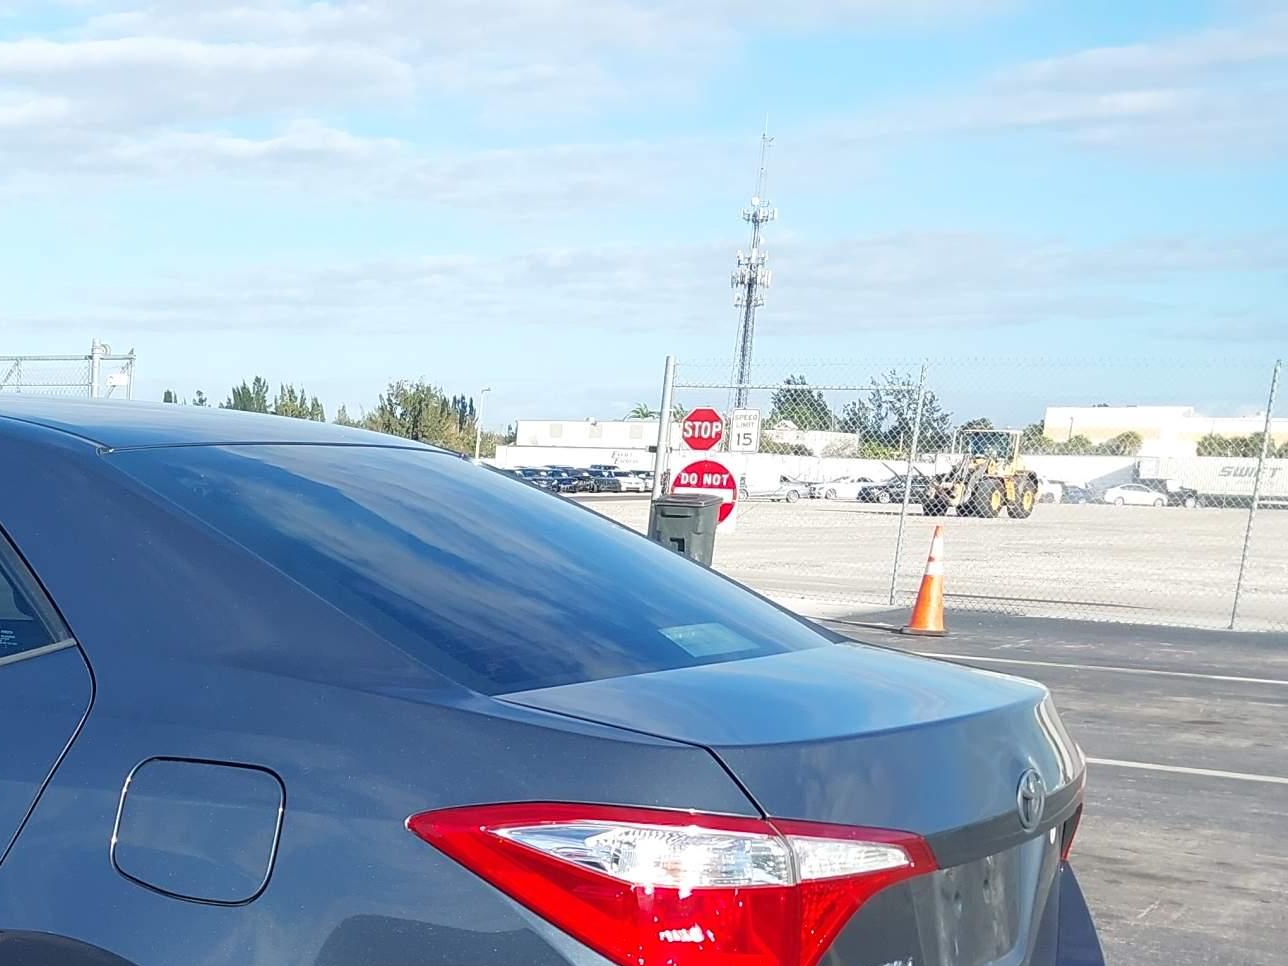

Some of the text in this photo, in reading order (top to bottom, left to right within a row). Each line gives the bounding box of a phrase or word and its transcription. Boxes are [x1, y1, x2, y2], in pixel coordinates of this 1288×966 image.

[683, 421, 722, 439] STOP
[736, 433, 753, 446] 15
[680, 472, 730, 486] DO NOT
